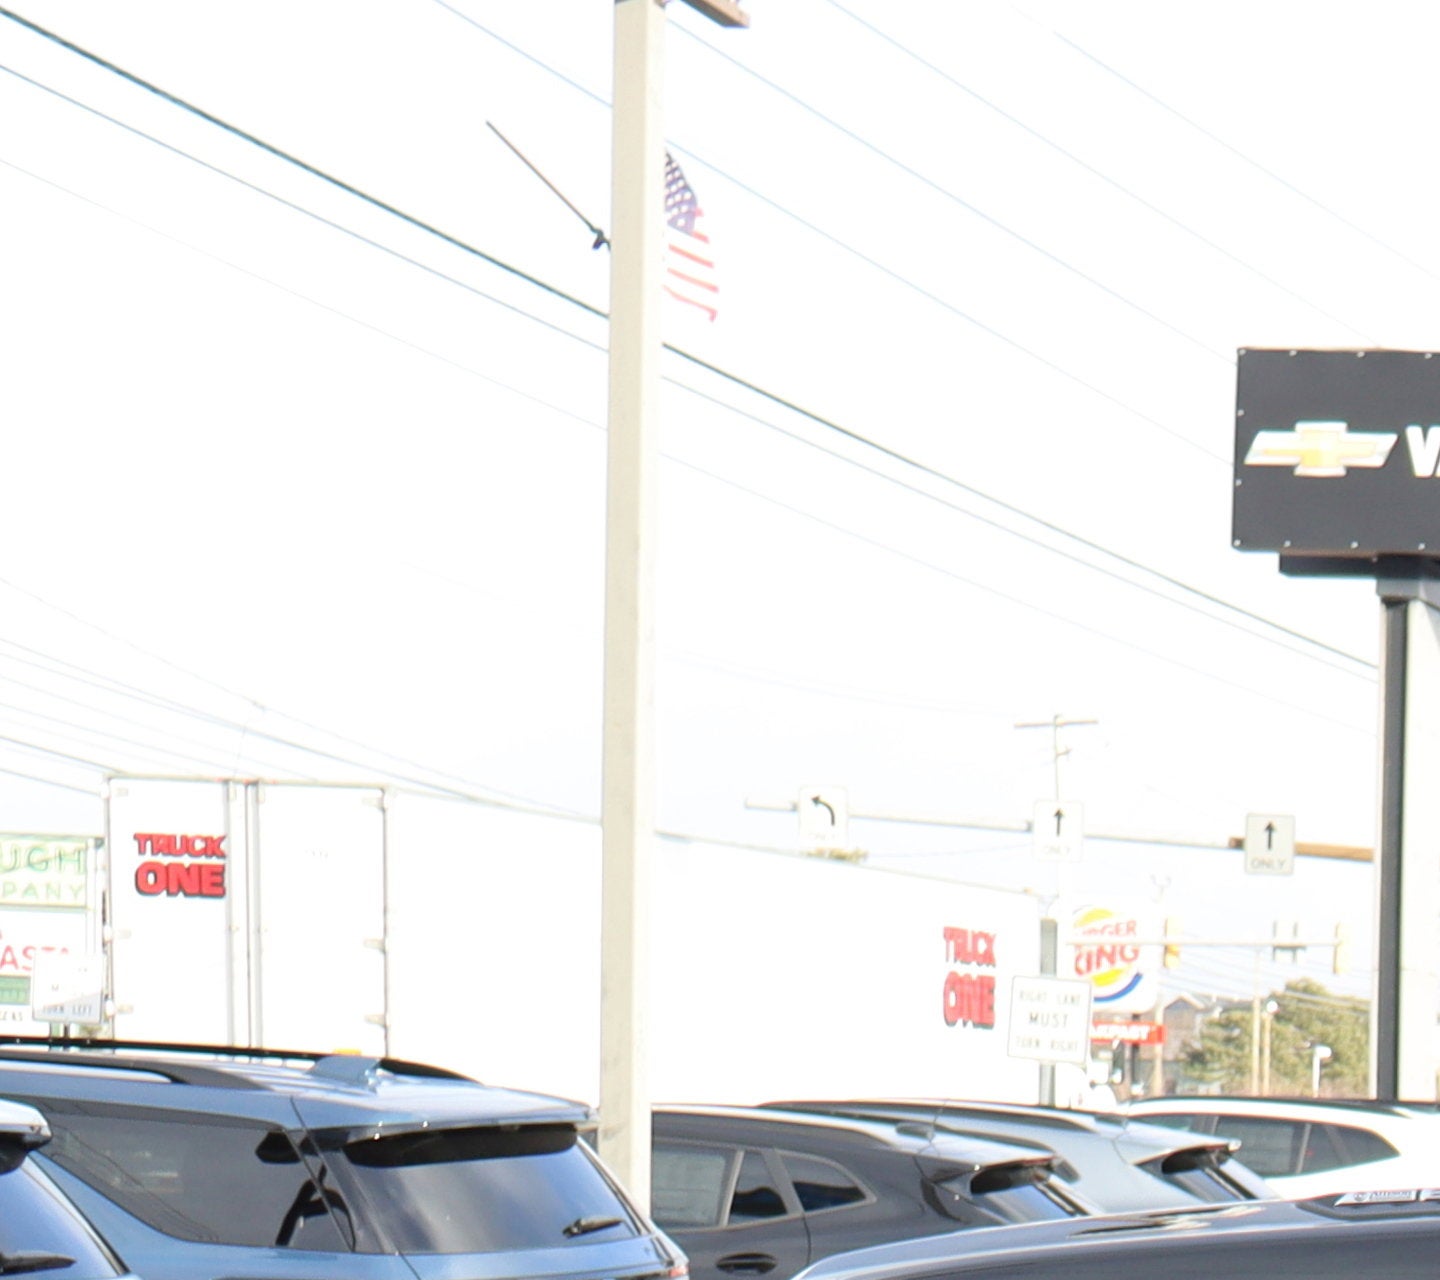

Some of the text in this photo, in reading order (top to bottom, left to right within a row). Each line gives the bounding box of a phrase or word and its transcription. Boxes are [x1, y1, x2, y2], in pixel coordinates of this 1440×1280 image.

[133, 832, 228, 858] TRUCK
[1250, 856, 1287, 870] ONLY
[134, 860, 228, 899] ONE
[943, 926, 997, 968] TRUCK
[943, 970, 997, 1030] ONE
[1028, 1011, 1068, 1028] MUST
